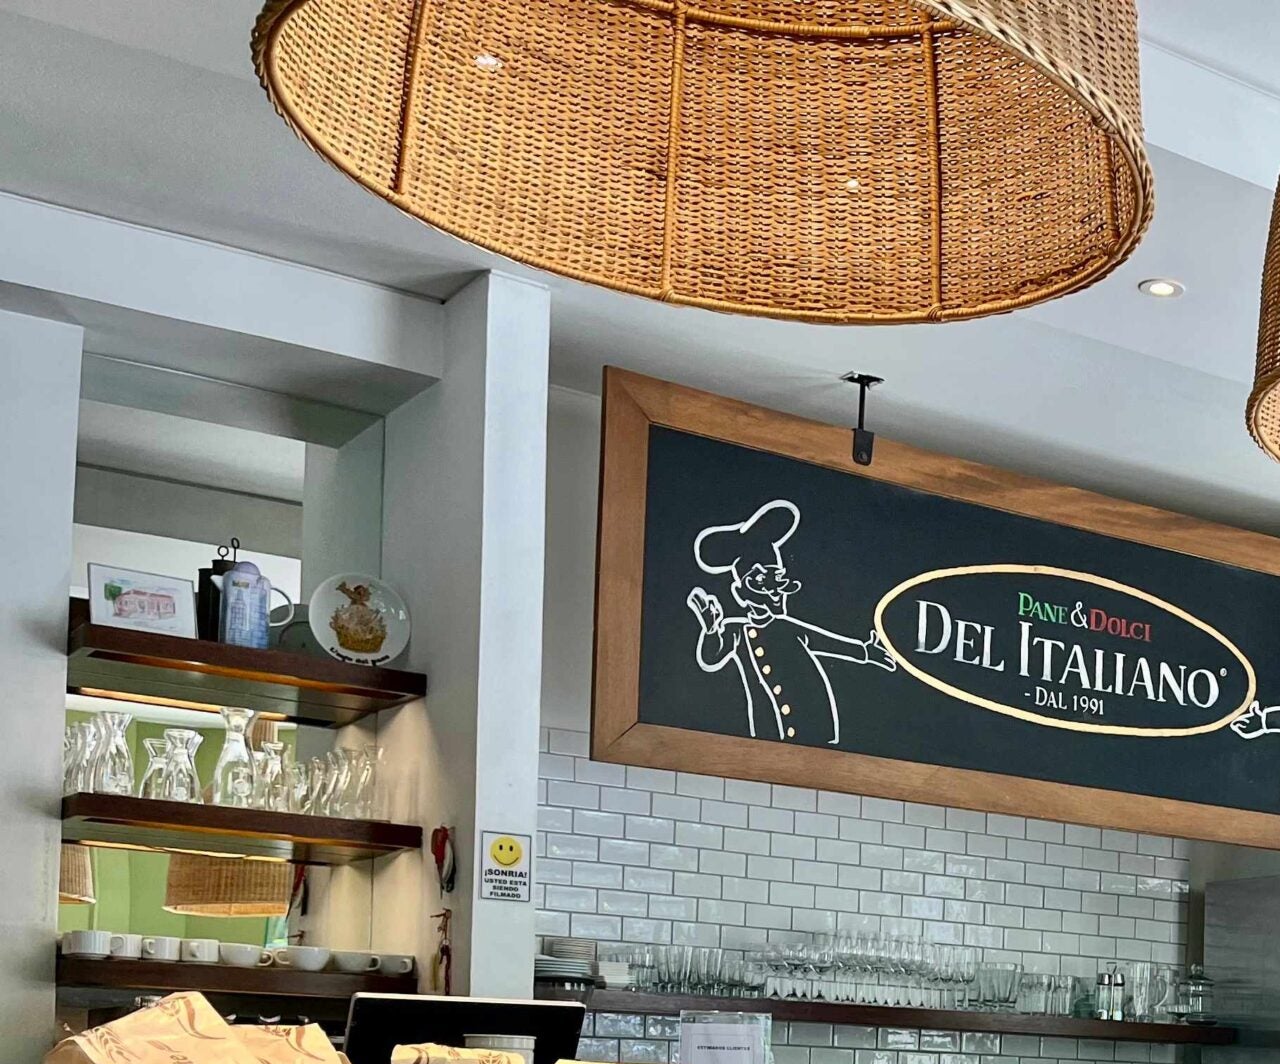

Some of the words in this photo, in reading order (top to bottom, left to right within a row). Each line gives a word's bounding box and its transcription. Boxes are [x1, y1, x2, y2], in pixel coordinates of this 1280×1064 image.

[914, 600, 1005, 672] DEL
[1035, 686, 1068, 711] DAL
[1072, 694, 1104, 715] 1991
